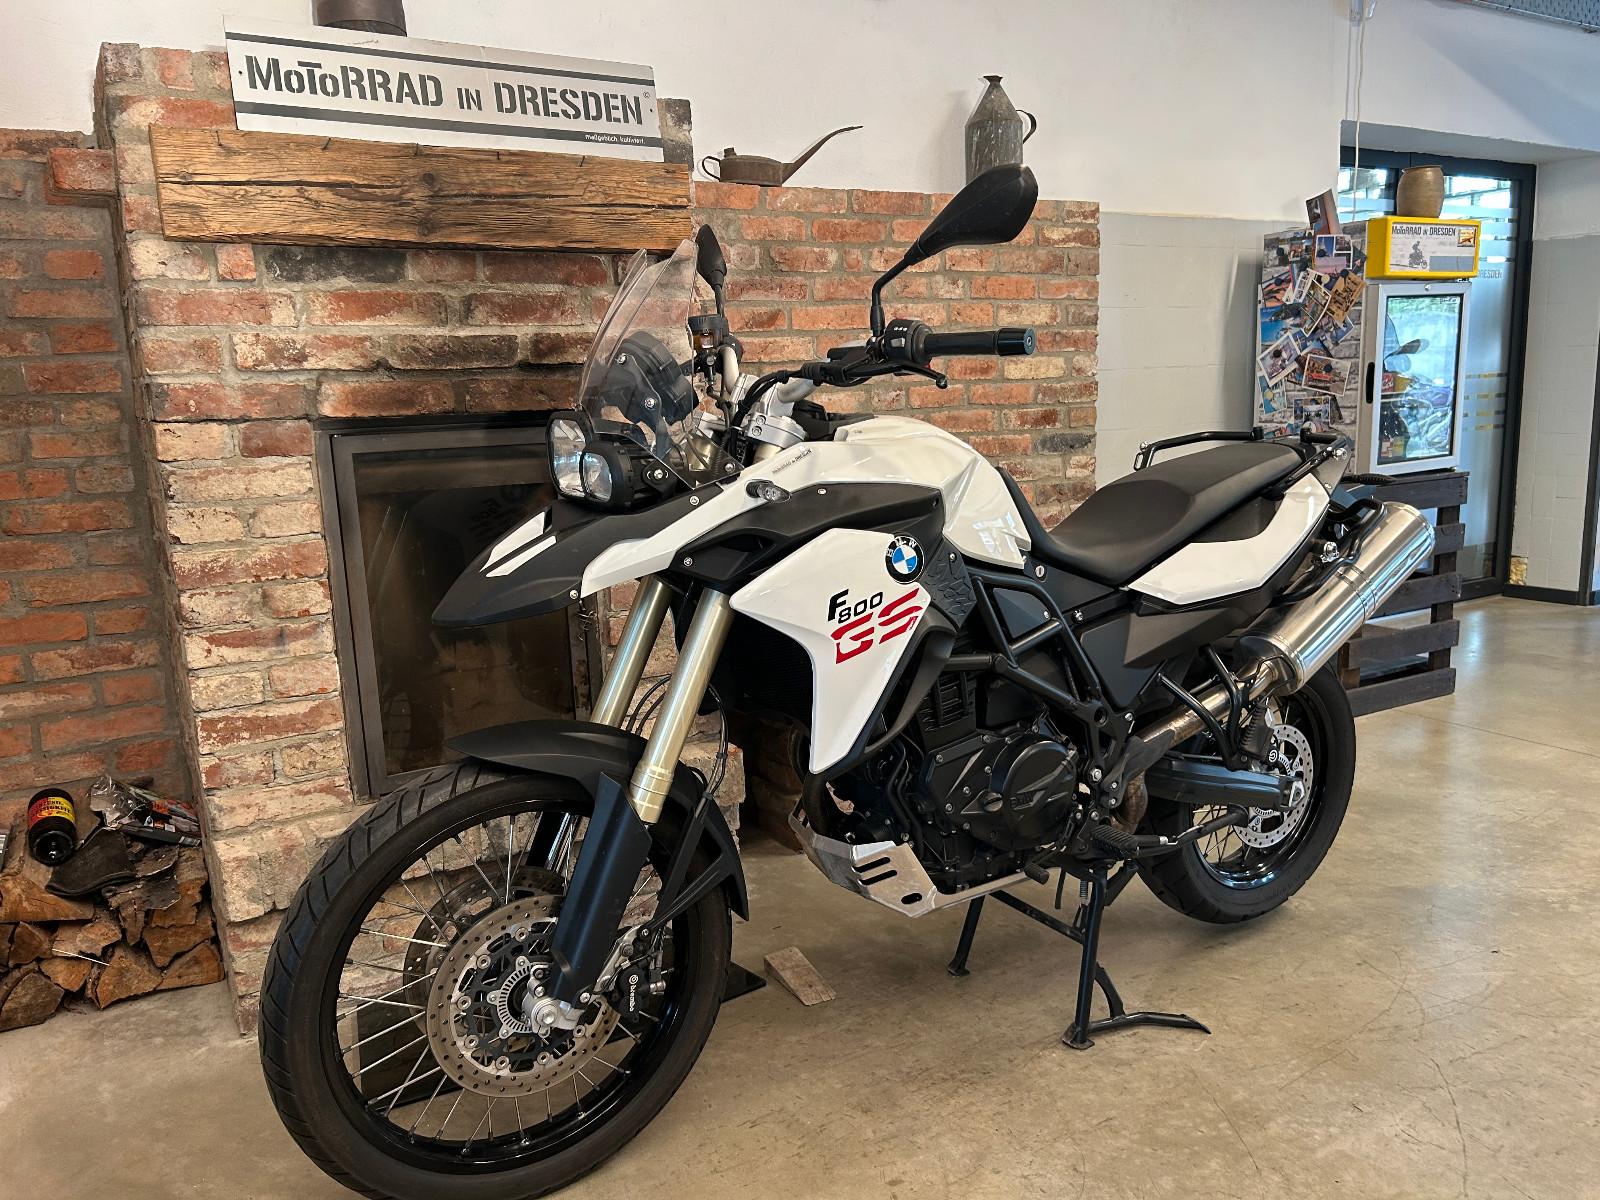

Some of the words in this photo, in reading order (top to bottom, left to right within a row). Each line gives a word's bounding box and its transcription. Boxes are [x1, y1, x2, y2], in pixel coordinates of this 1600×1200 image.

[457, 87, 482, 111] IN
[493, 82, 643, 125] DRESDEN
[1429, 227, 1456, 236] DRESDEN
[830, 587, 923, 664] GS
